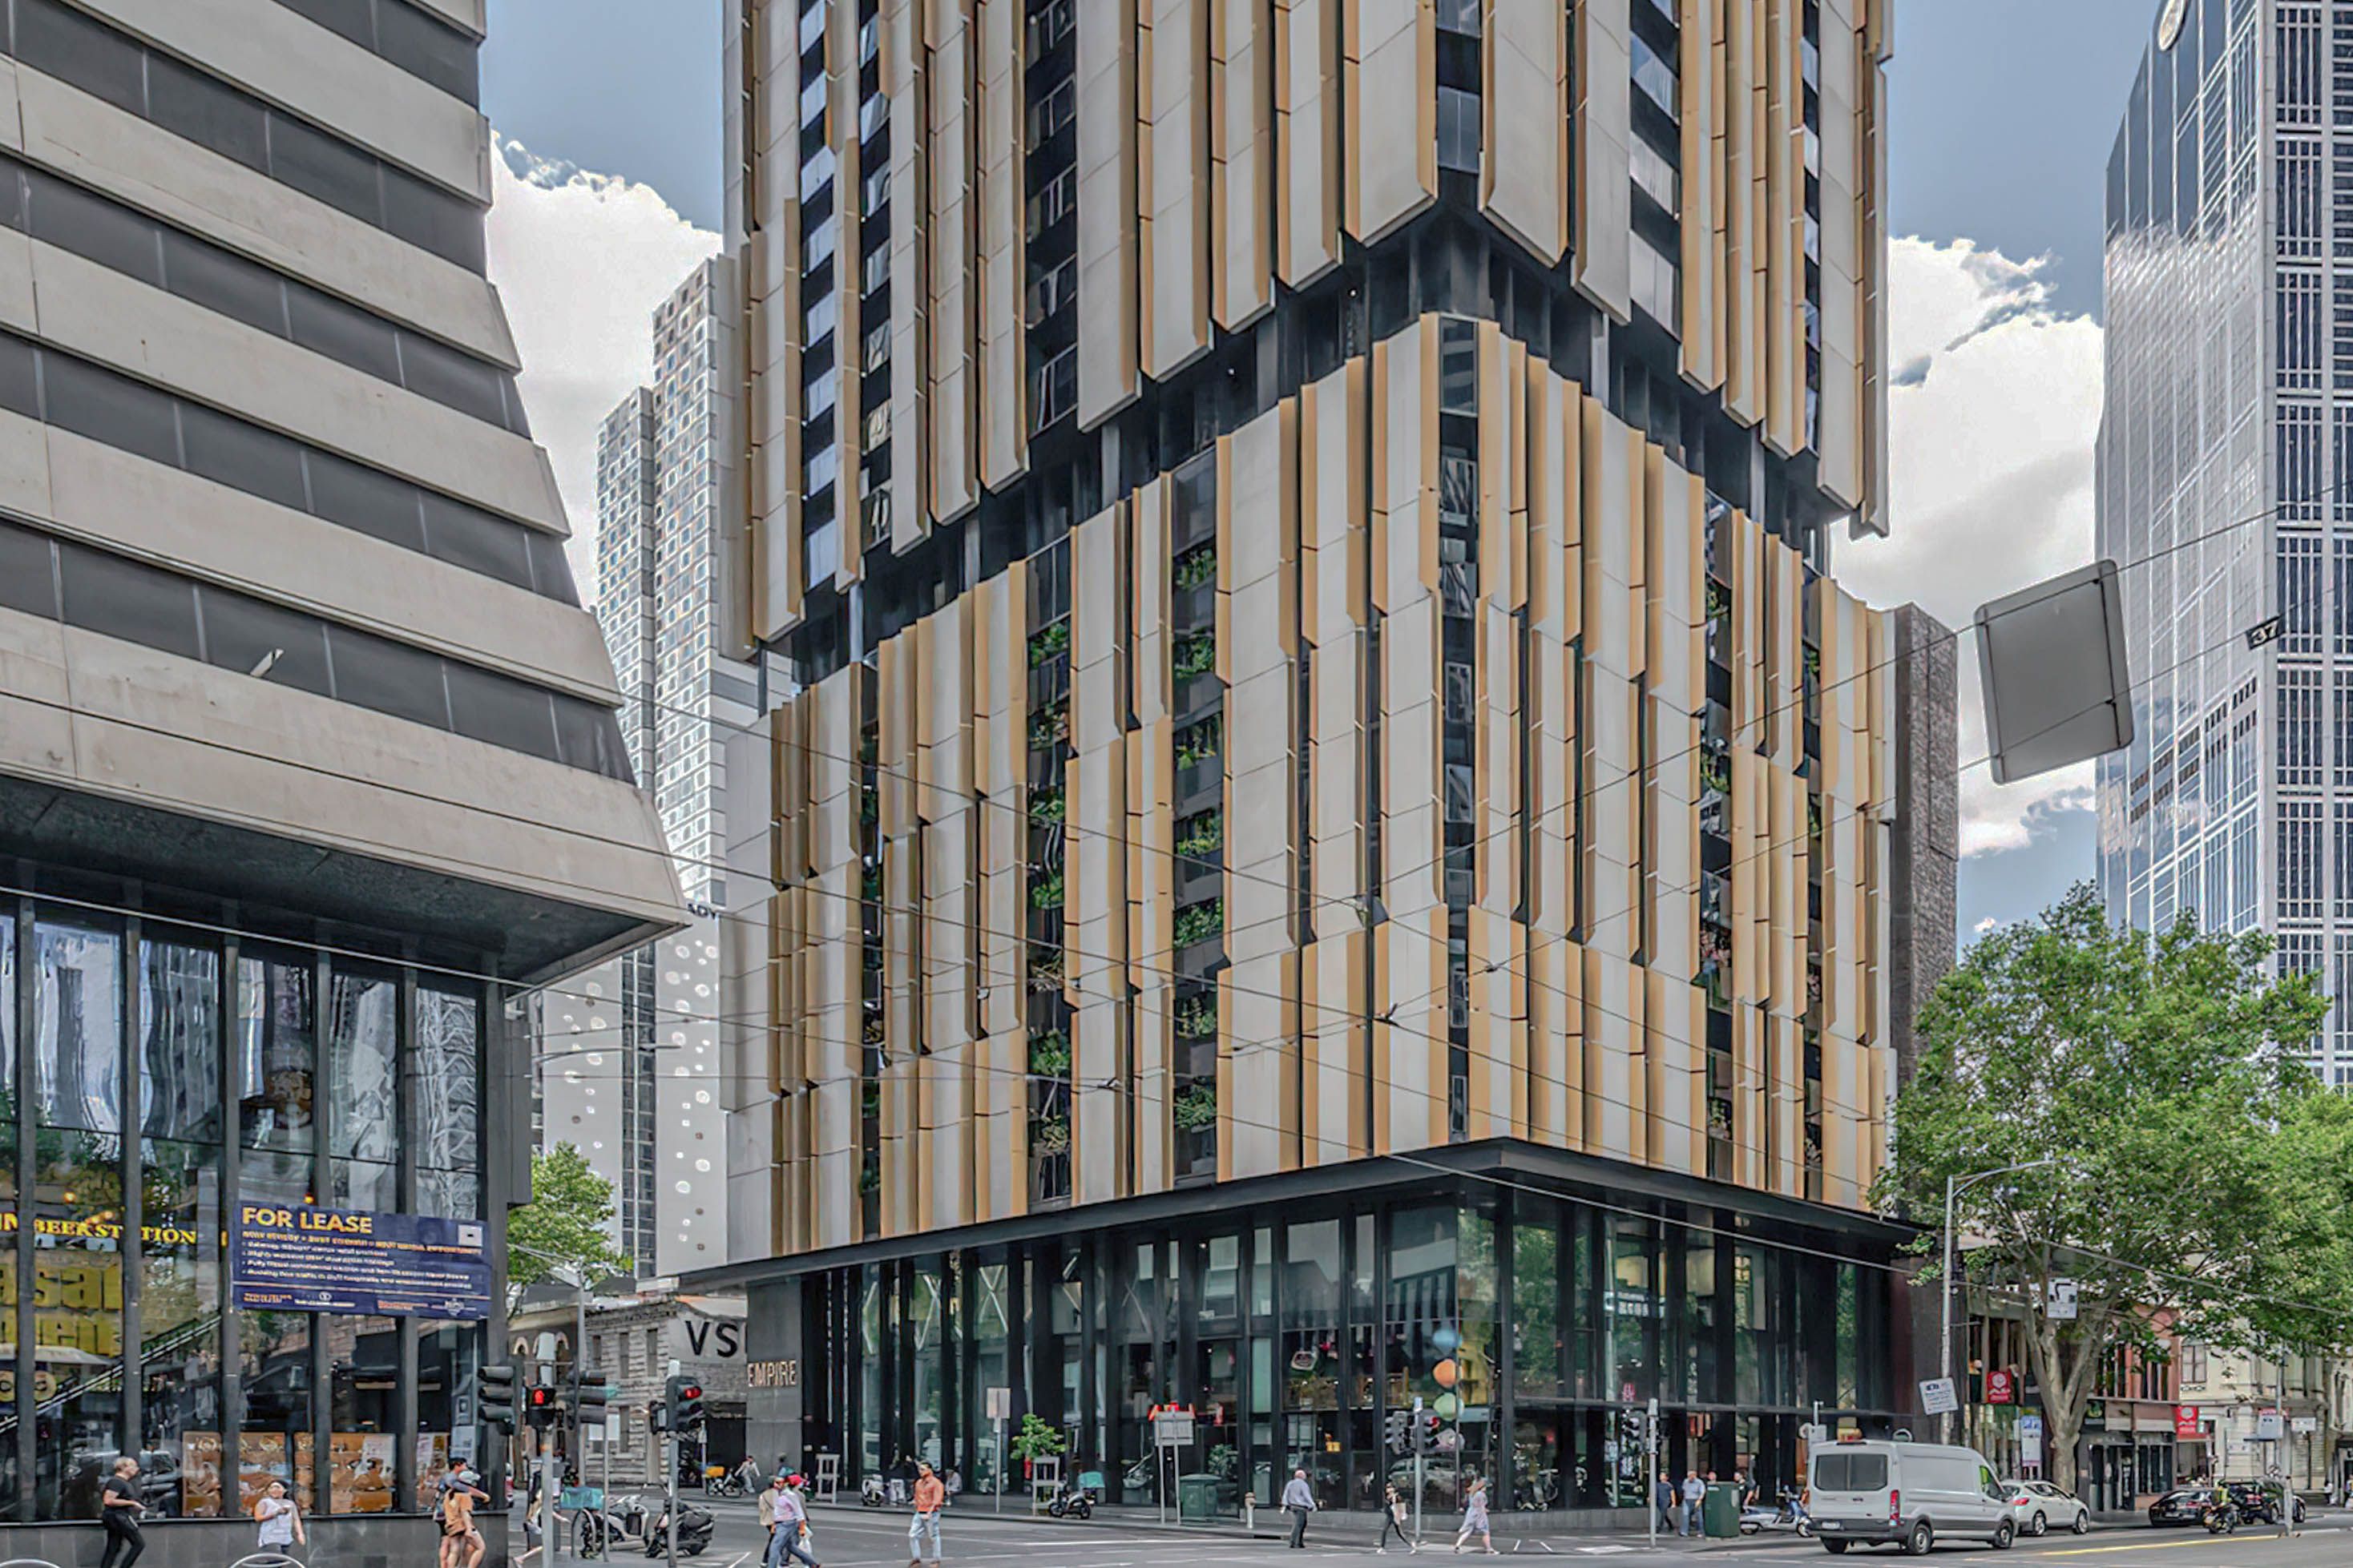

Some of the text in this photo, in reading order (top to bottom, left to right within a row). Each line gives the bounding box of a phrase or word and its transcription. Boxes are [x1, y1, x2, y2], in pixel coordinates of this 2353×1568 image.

[2251, 620, 2277, 644] 37
[95, 1223, 197, 1244] STTION
[242, 1207, 373, 1234] FOR LEASE
[685, 1320, 748, 1357] VS
[748, 1360, 797, 1387] EMPIRE
